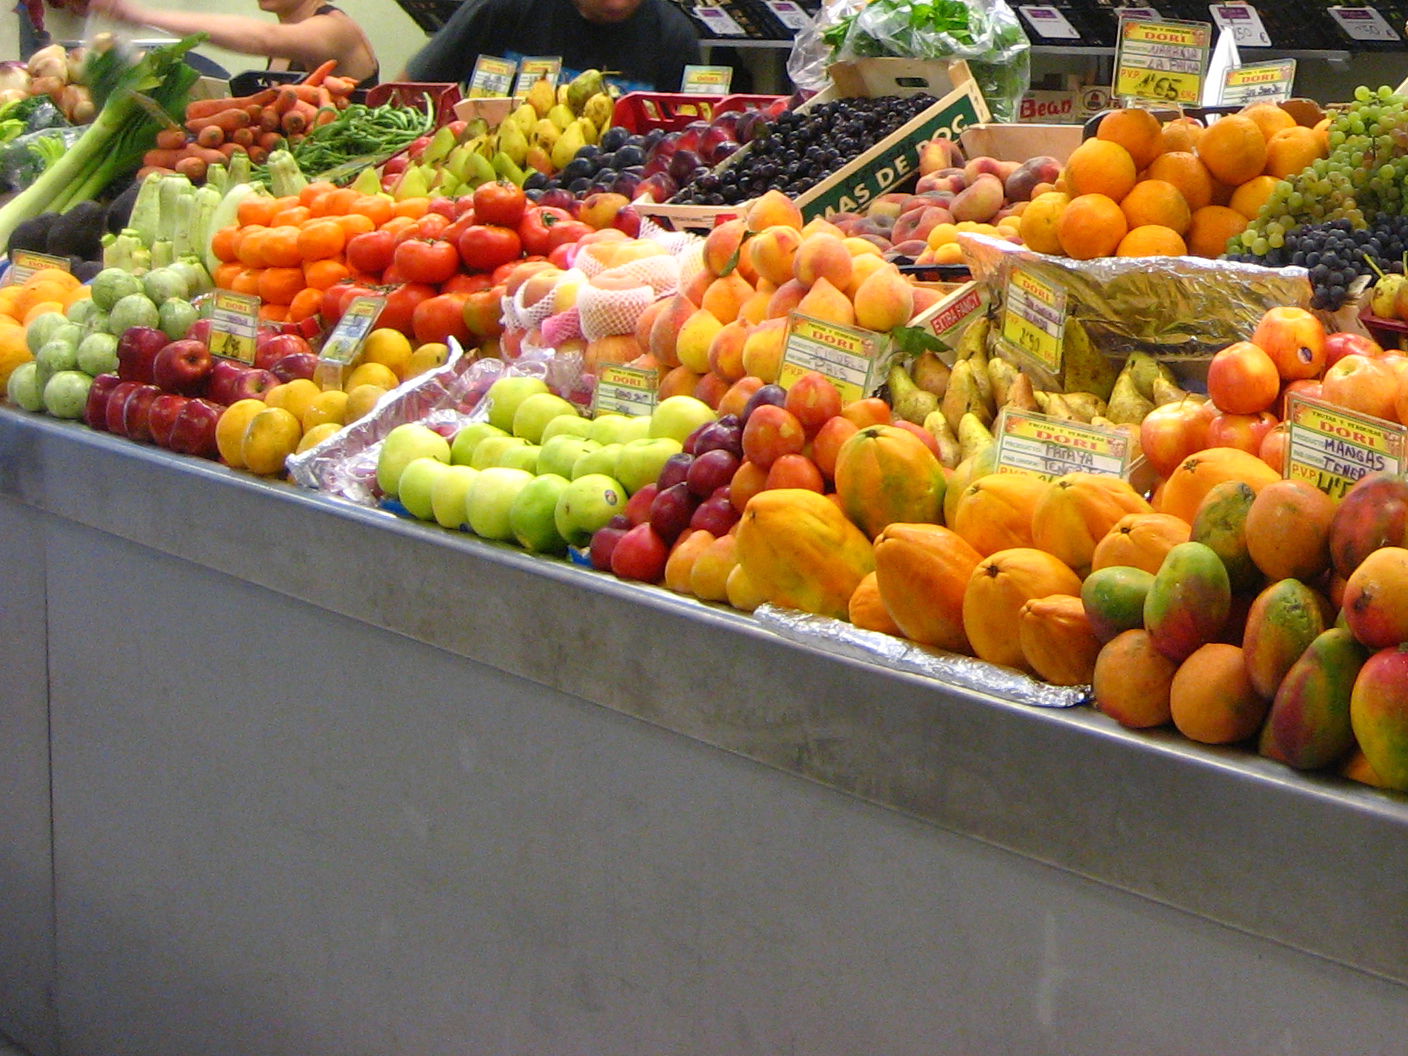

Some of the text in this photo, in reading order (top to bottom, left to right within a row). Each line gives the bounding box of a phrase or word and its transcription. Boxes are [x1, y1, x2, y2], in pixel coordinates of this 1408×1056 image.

[1145, 32, 1187, 43] DORI
[1020, 98, 1073, 119] Bean
[875, 154, 910, 190] DE
[1023, 280, 1050, 300] DORI
[811, 330, 854, 350] DORI
[1036, 430, 1098, 450] DORI
[1320, 420, 1375, 446] DORI
[1045, 442, 1094, 466] PAPAYA
[1324, 438, 1386, 472] MANGAS
